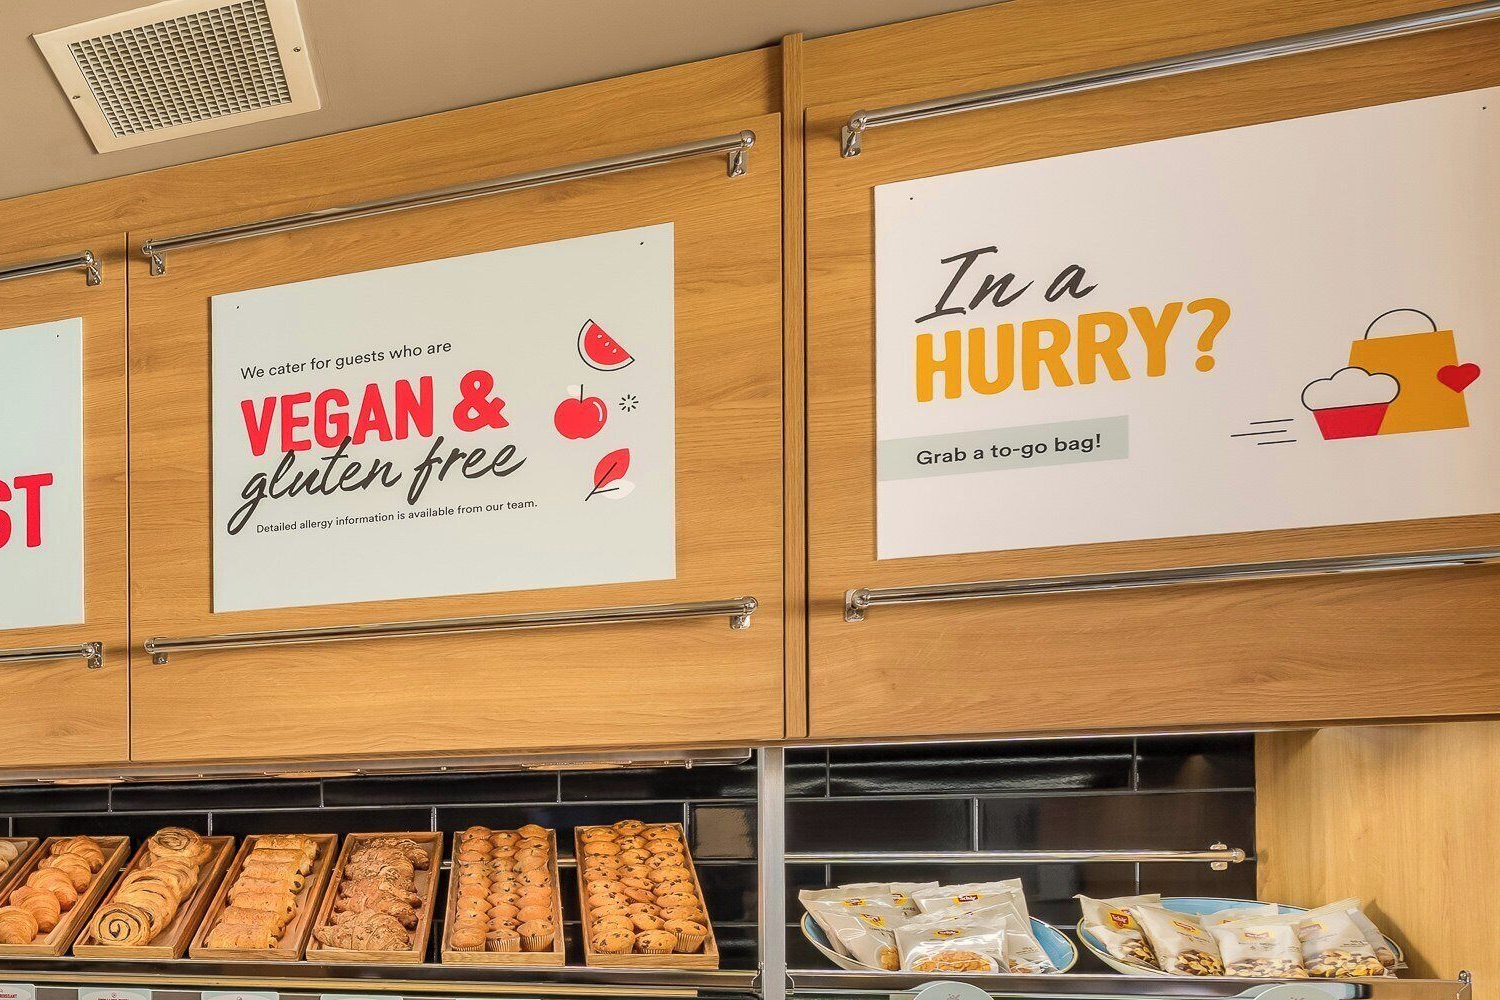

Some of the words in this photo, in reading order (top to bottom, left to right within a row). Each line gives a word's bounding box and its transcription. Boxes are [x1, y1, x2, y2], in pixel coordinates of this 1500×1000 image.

[914, 245, 1035, 324] In
[1044, 265, 1098, 302] a
[241, 366, 264, 379] We
[269, 363, 306, 375] cater
[311, 358, 331, 370] for
[336, 351, 384, 369] guests
[389, 345, 422, 359] who
[428, 343, 451, 354] are
[915, 298, 1231, 402] HURRY?
[241, 376, 433, 456] VEGAN
[452, 370, 509, 432] &
[917, 448, 966, 465] Grab
[974, 450, 983, 459] a
[991, 443, 1047, 461] to-go
[1055, 434, 1100, 455] bag!
[227, 436, 403, 535] gluten
[407, 436, 527, 505] free
[257, 521, 296, 533] Detailed
[300, 520, 333, 531] allergy
[336, 513, 394, 525] information
[398, 511, 405, 519] is
[409, 504, 454, 519] available
[458, 505, 482, 514] from
[507, 501, 537, 509] team.
